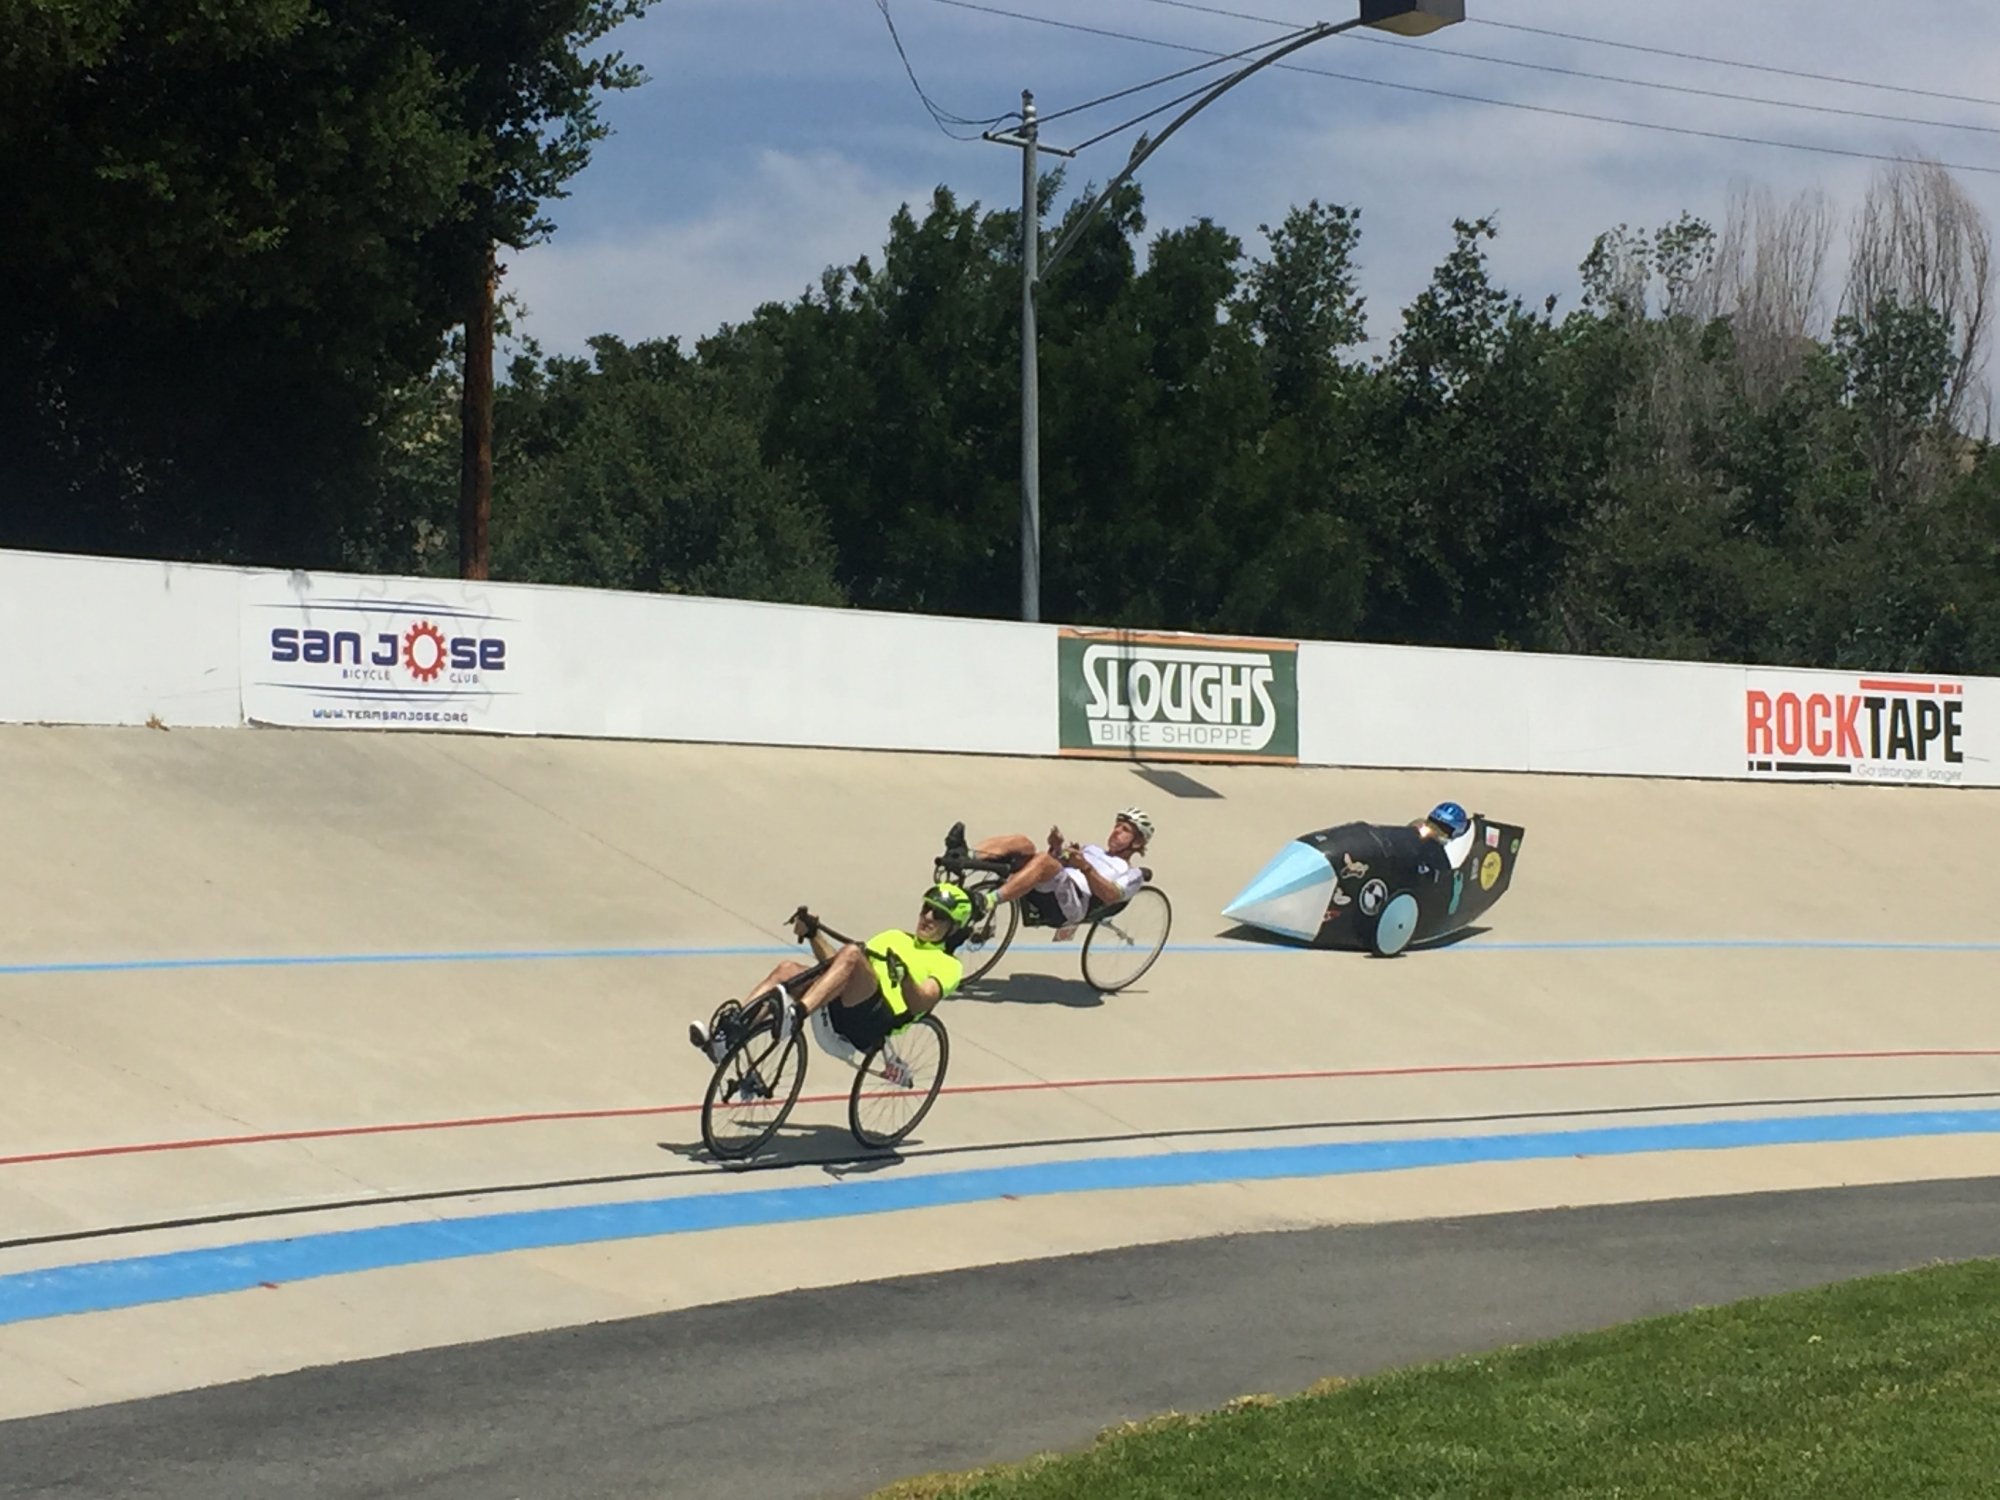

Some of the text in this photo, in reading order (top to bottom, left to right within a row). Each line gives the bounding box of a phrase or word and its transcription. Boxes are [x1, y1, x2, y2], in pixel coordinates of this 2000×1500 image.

[342, 669, 480, 685] BICYCLE CLUB
[1082, 644, 1276, 751] SLOUGHS
[1100, 723, 1253, 746] BIKE SHOPPE
[1746, 690, 1964, 763] ROCKTAPE
[1857, 763, 1875, 777] Go
[1927, 768, 1962, 783] longer
